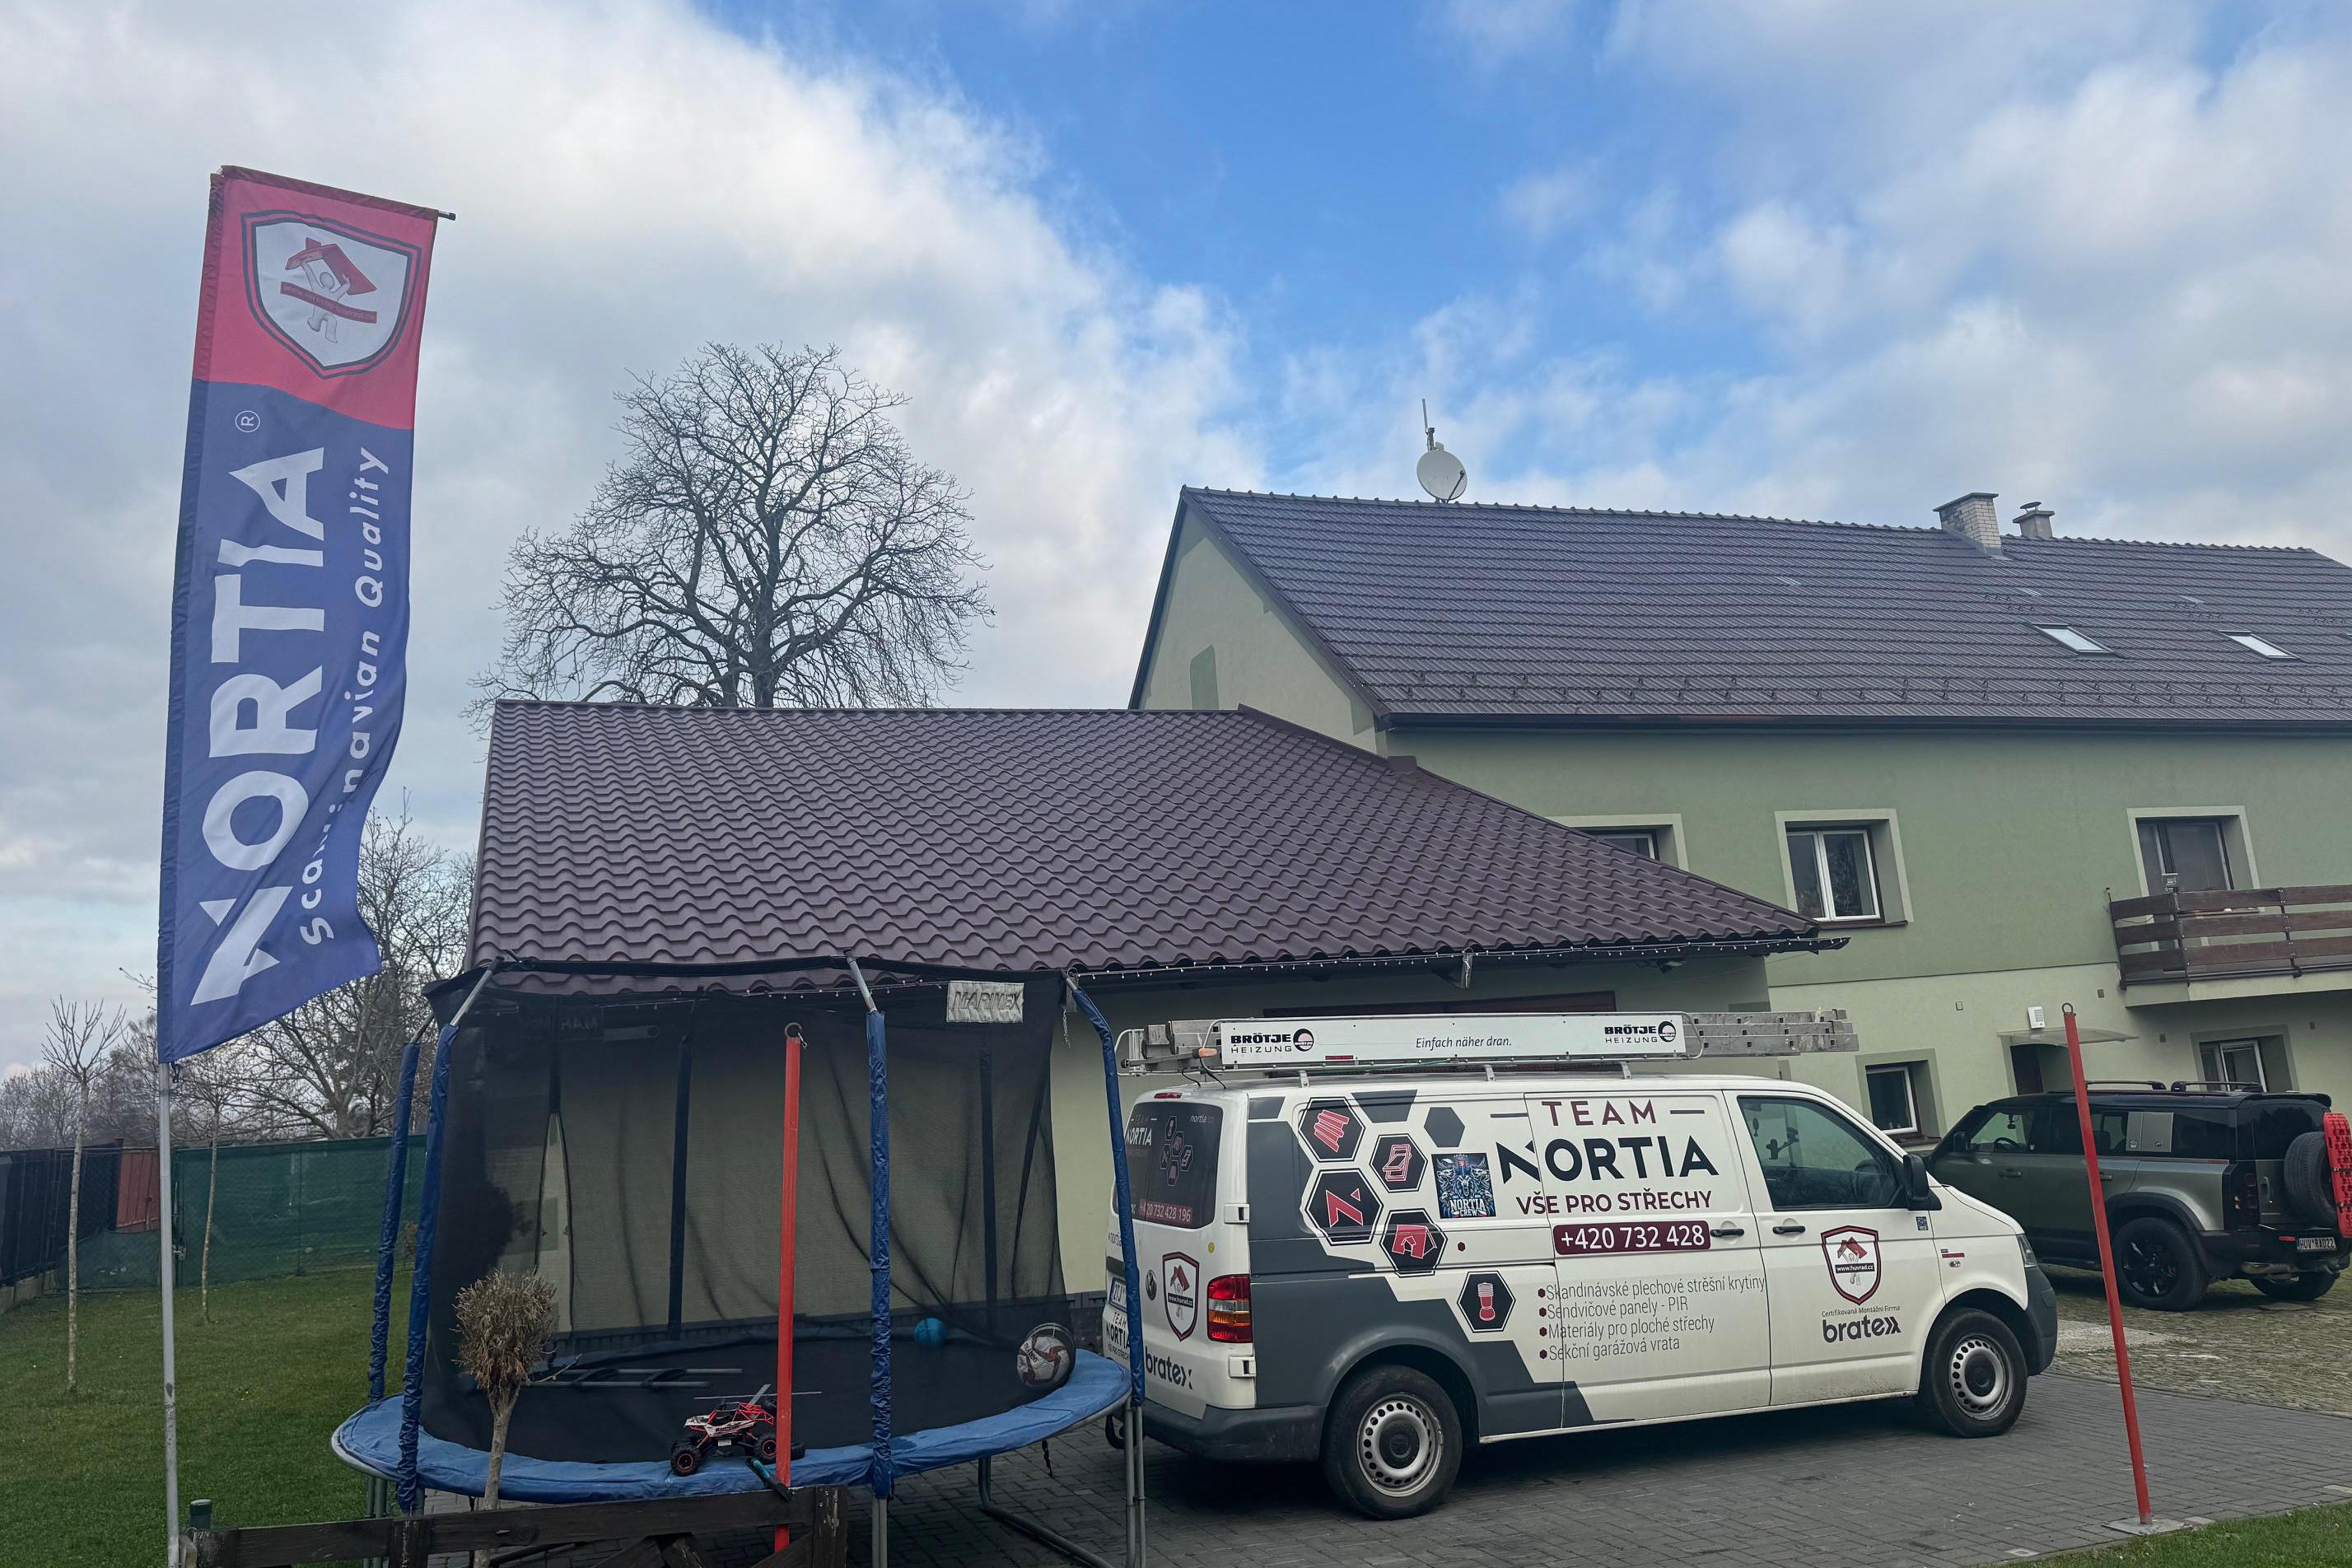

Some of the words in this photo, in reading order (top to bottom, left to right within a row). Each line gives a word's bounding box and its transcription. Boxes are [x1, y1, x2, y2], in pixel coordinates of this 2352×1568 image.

[348, 446, 390, 608] Quality
[190, 447, 324, 1006] NORTIA
[1230, 1032, 1291, 1044] BRÖTJE
[1604, 1024, 1657, 1035] BRÖTJE
[1605, 1035, 1658, 1043] HEIZUNG
[1231, 1045, 1292, 1054] HEIZUNG
[1416, 1037, 1453, 1051] Einfach
[1455, 1036, 1485, 1048] näher
[1486, 1036, 1512, 1047] dran.
[1542, 1099, 1657, 1127] TEAM
[1125, 1127, 1153, 1146] NORTIA
[1496, 1135, 1720, 1184] NORTIA
[1153, 1204, 1164, 1218] 732
[1164, 1205, 1178, 1220] 428
[1178, 1206, 1192, 1222] 196
[1449, 1198, 1486, 1212] NORTIA
[1459, 1209, 1478, 1217] CREW
[1516, 1191, 1560, 1216] VŠE
[1566, 1193, 1612, 1213] PRO
[1617, 1188, 1712, 1211] STŘECHY
[1561, 1227, 1616, 1249] +420
[1619, 1226, 1661, 1248] 732
[1666, 1225, 1705, 1247] 428
[1632, 1277, 1684, 1299] plechové
[1729, 1274, 1766, 1294] krytiny
[1547, 1300, 1617, 1320] Sendvičové
[1620, 1298, 1658, 1318] panely
[1668, 1295, 1688, 1312] PIR
[1822, 1308, 1858, 1318] Certifikovaná
[1858, 1305, 1883, 1314] Montážní
[1548, 1322, 1604, 1342] Materiály
[1608, 1324, 1627, 1340] pro
[1631, 1317, 1669, 1337] ploché
[1673, 1314, 1715, 1333] střechy
[1822, 1314, 1902, 1343] bratex
[1549, 1342, 1589, 1360] Sekční
[1593, 1337, 1647, 1360] garážová
[1650, 1337, 1680, 1351] vrata
